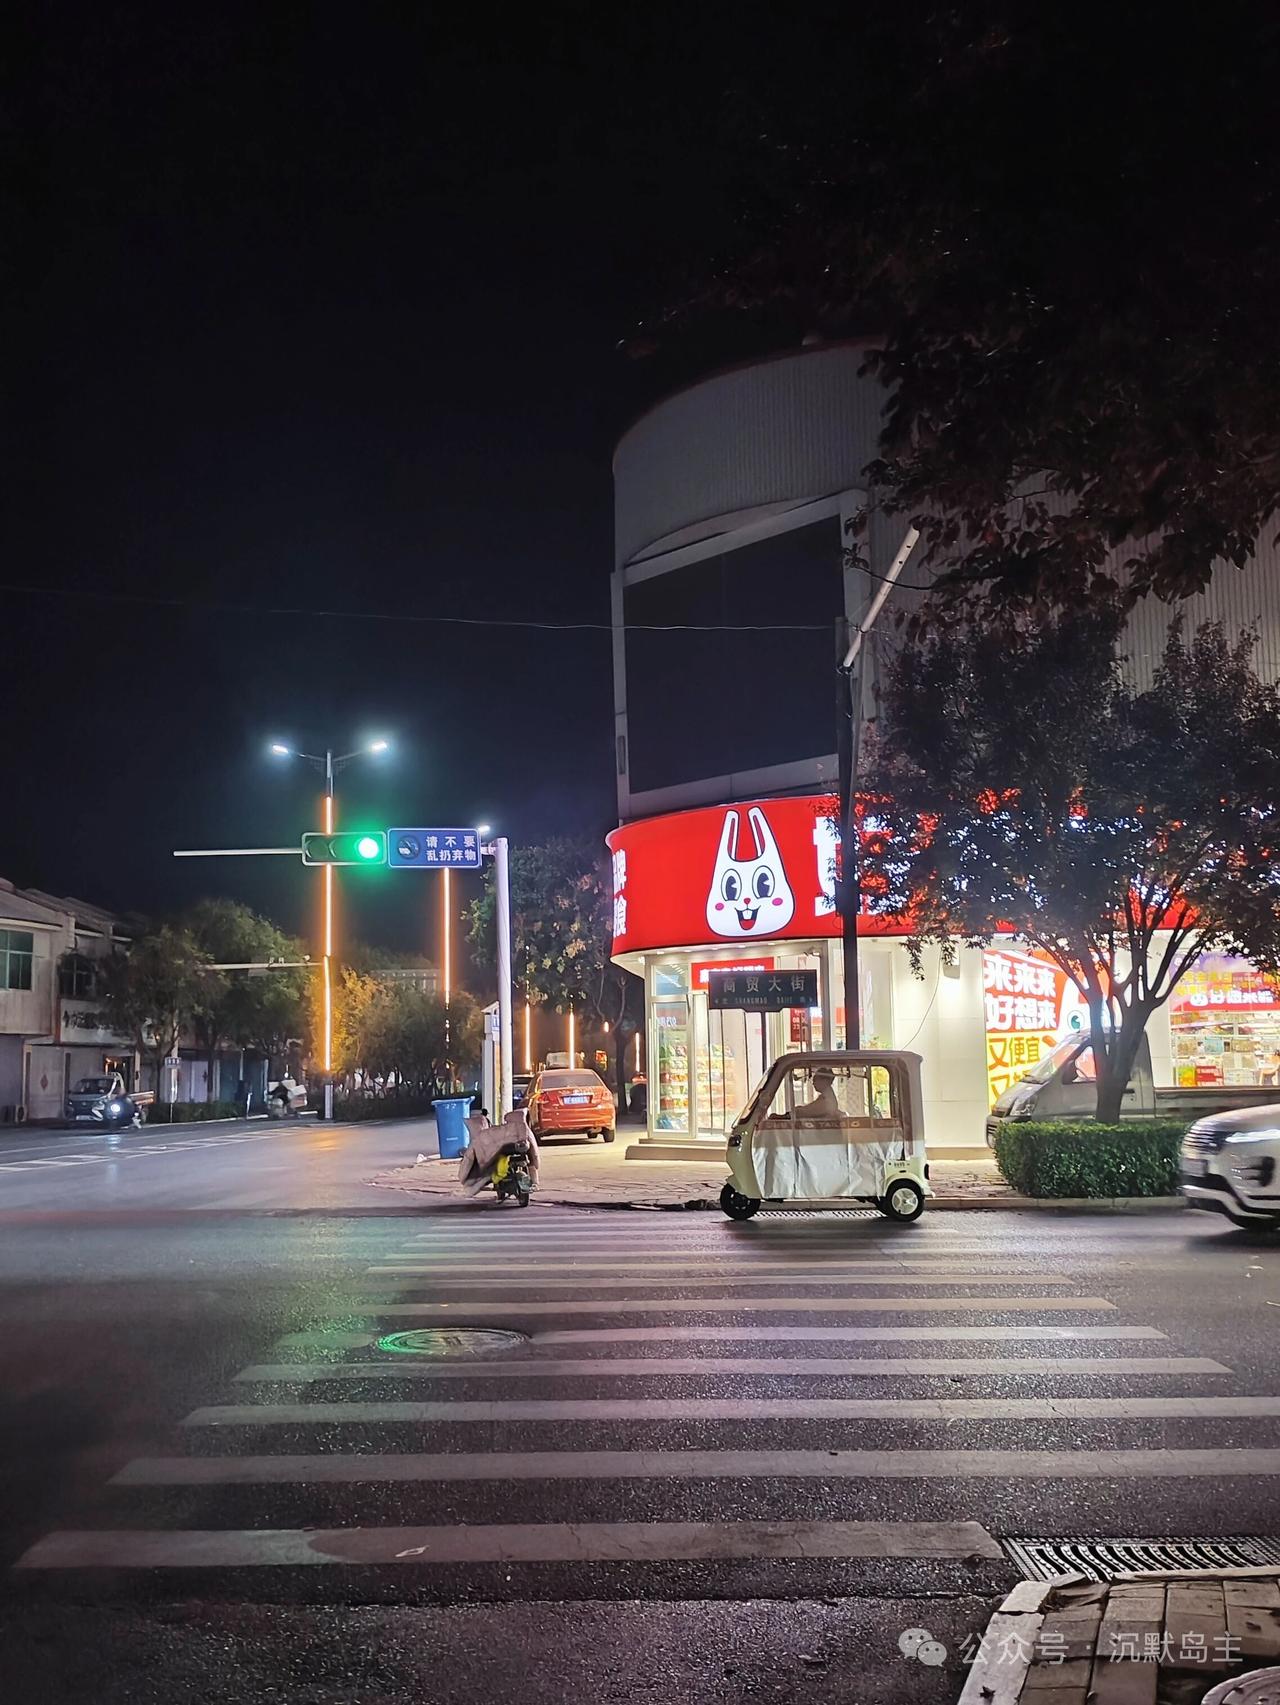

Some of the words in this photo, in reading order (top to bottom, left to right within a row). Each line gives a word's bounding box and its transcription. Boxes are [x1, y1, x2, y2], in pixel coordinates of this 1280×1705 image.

[426, 835, 475, 848] 请不要
[426, 849, 476, 862] 乱扔弃物
[723, 975, 805, 993] 商贸大街
[983, 993, 1057, 1030] 好想来
[988, 1036, 1040, 1071] 又便宜
